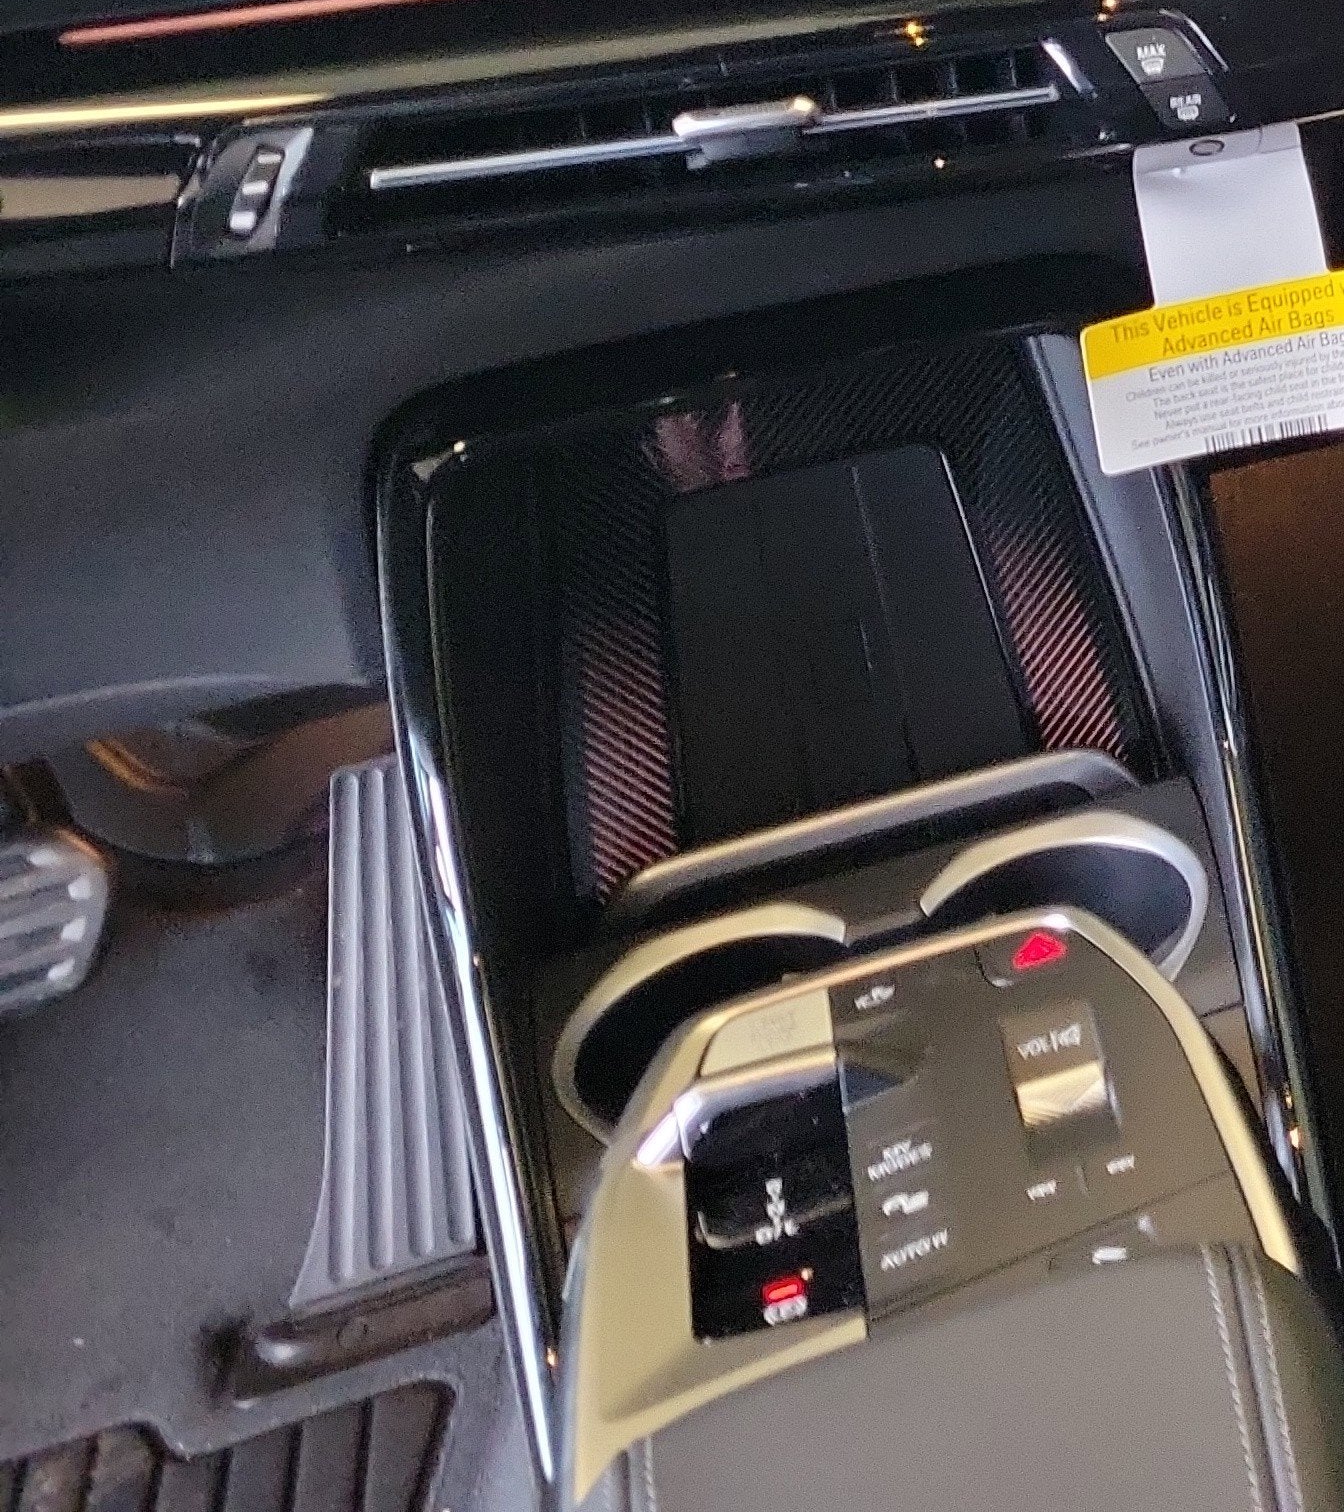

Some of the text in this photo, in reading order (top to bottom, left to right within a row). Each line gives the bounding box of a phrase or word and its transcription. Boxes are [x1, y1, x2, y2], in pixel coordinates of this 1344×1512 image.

[1137, 43, 1166, 61] MAX
[1169, 93, 1201, 109] REAR
[1110, 322, 1149, 344] This
[1153, 303, 1223, 333] Vehicle
[1228, 298, 1243, 316] is
[1246, 278, 1334, 314] Equipped
[1162, 307, 1335, 357] Advanced Air Bags
[1149, 363, 1184, 382] Even
[1189, 356, 1218, 375] with
[1223, 339, 1293, 364] Advanced
[1297, 334, 1315, 350] Air
[1305, 366, 1318, 374] for
[1169, 382, 1185, 390] can
[1201, 371, 1226, 382] killed
[1320, 375, 1336, 384] the
